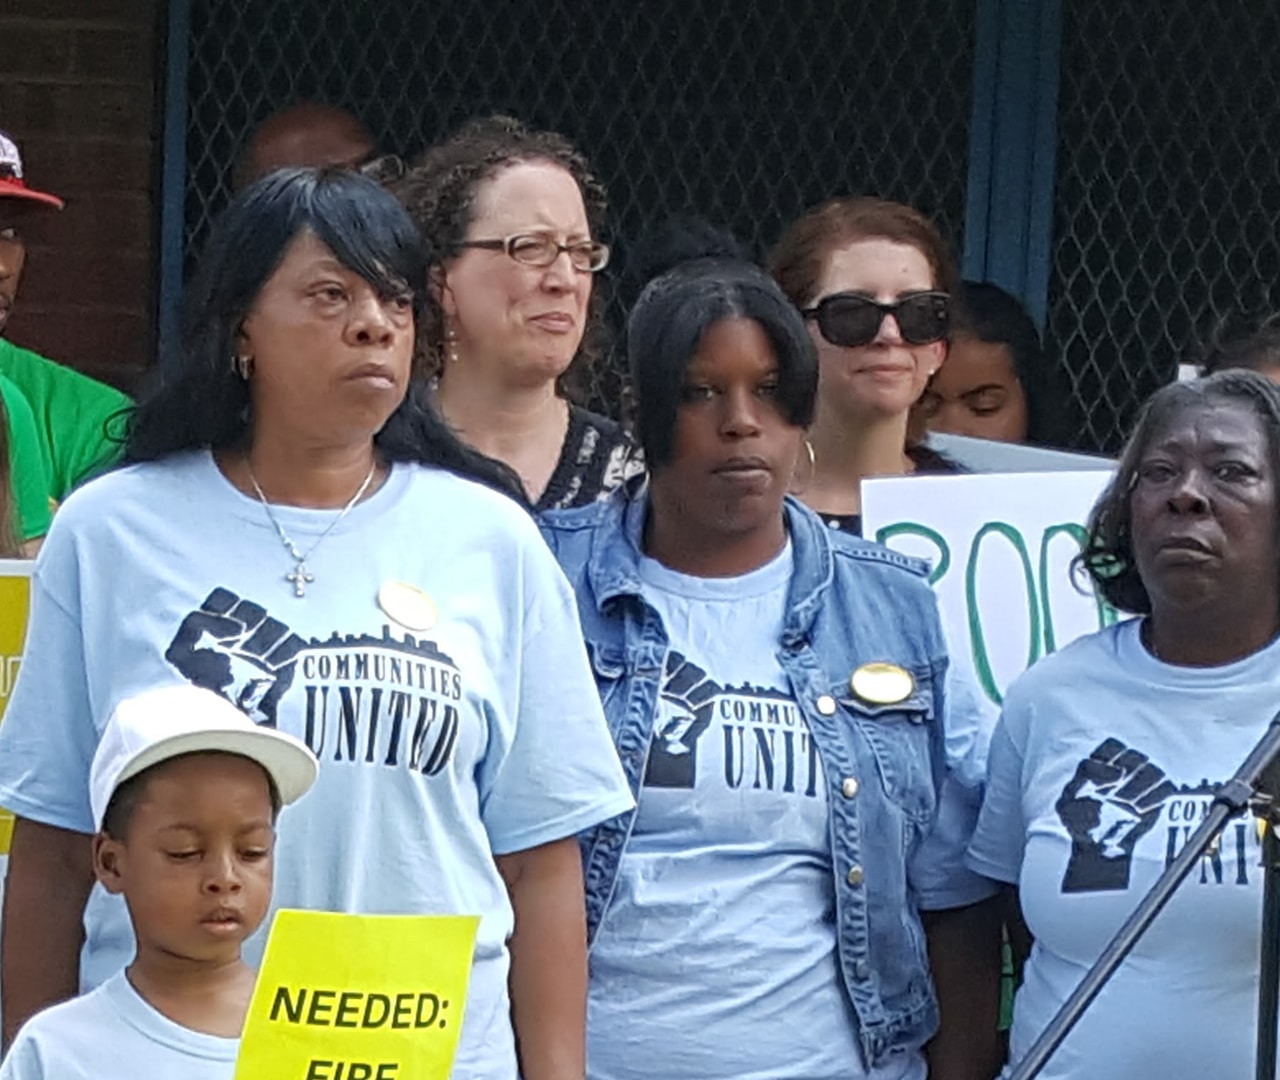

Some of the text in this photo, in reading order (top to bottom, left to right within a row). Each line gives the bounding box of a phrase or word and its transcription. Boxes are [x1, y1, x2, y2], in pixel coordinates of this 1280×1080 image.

[302, 652, 462, 701] COMMUNITIES
[303, 685, 460, 778] UNITED
[720, 698, 804, 728] COMMU
[269, 986, 450, 1030] NEEDED:
